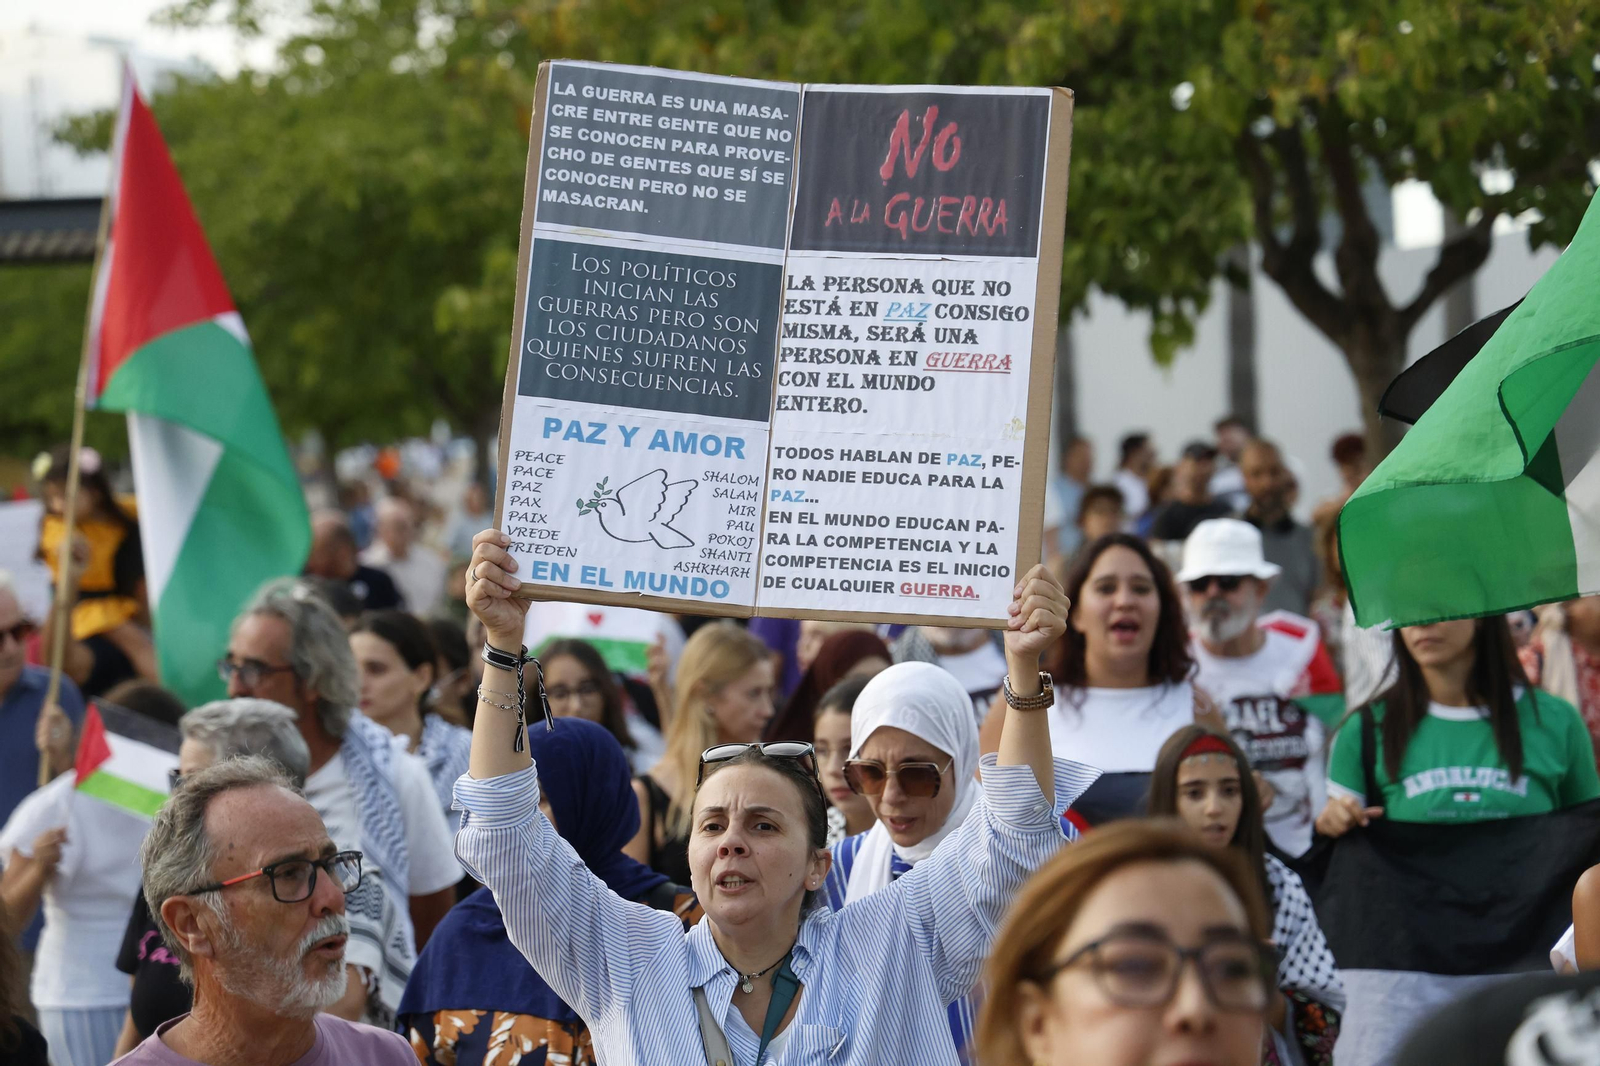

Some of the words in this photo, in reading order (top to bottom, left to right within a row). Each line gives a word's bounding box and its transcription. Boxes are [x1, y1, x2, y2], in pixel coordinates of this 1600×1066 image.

[554, 82, 577, 96] LA
[582, 85, 656, 106] GUERRA
[662, 95, 684, 109] ES
[690, 98, 728, 114] UNA
[733, 103, 789, 120] MASA-
[552, 104, 588, 119] CRE
[593, 108, 653, 127] ENTRE
[658, 116, 718, 134] GENTE
[723, 124, 761, 139] QUE
[766, 128, 792, 142] NO
[549, 125, 572, 139] SE
[578, 128, 666, 150] CONOCEN
[671, 139, 719, 156] PARA
[724, 145, 790, 164] PROVE-
[548, 147, 586, 162] CHO
[591, 151, 615, 166] DE
[620, 155, 692, 175] GENTES
[697, 164, 735, 180] QUE
[739, 166, 758, 182] SÍ
[762, 171, 785, 185] SE
[545, 168, 634, 190] CONOCEN
[639, 179, 687, 196] PERO
[692, 185, 718, 199] NO
[723, 188, 747, 203] SE
[543, 189, 648, 213] MASACRAN.
[825, 198, 841, 226] A
[885, 192, 1007, 239] GUERRA
[621, 261, 737, 288] POLÍTICOS
[584, 279, 674, 303] INICIAN
[684, 290, 719, 308] LAS
[786, 275, 816, 291] LA
[822, 276, 925, 294] PERSONA
[932, 279, 975, 297] QUE
[981, 280, 1011, 297] NO
[538, 296, 638, 321] GUERRAS
[649, 308, 705, 328] PERO
[713, 315, 759, 334] SON
[784, 295, 842, 316] ESTÁ
[849, 301, 879, 317] EN
[886, 302, 933, 319] PAZ
[935, 303, 1029, 322] CONSIGO
[548, 319, 586, 337] LOS
[595, 324, 746, 355] CIUDADANOS
[782, 322, 859, 343] MISMA,
[866, 322, 927, 342] SERÁ
[934, 327, 979, 345] UNA
[527, 338, 623, 363] QUIENES
[632, 350, 716, 373] SUFREN
[727, 360, 761, 378] LAS
[780, 347, 882, 366] PERSONA
[888, 350, 918, 367] EN
[924, 352, 1013, 371] GUERRA
[546, 360, 738, 398] CONSECUENCIAS.
[778, 371, 821, 387] CON
[826, 372, 855, 389] EL
[860, 373, 935, 391] MUNDO
[776, 395, 868, 414] ENTERO.
[543, 417, 607, 445] PAZ
[618, 425, 640, 448] Y
[648, 429, 745, 460] AMOR
[515, 450, 566, 465] PEACE
[774, 446, 834, 460] TODOS
[840, 449, 912, 464] HABLAN
[918, 452, 941, 465] DE
[947, 453, 986, 470] PAZ,
[992, 455, 1020, 468] PE-
[513, 465, 555, 479] PACE
[702, 471, 759, 487] SHALOM
[772, 468, 797, 480] RO
[802, 469, 856, 483] NADIE
[862, 471, 922, 486] EDUCA
[928, 474, 976, 488] PARA
[981, 477, 1004, 490] LA
[512, 480, 543, 493] PAZ
[712, 487, 758, 502] SALAM
[771, 490, 819, 503] PAZ...
[510, 495, 541, 508] PAX
[728, 503, 756, 517] MIR
[508, 511, 547, 524] PAIX
[727, 520, 755, 532] PAU
[769, 511, 792, 524] EN
[798, 512, 819, 525] EL
[824, 513, 890, 528] MUNDO
[896, 516, 970, 532] EDUCAN
[976, 520, 1005, 533] PA-
[507, 525, 561, 541] VREDE
[708, 533, 755, 549] POKOJ
[767, 533, 790, 545] RA
[796, 534, 818, 547] LA
[823, 535, 953, 553] COMPETENCIA
[958, 541, 971, 553] Y
[976, 542, 998, 555] LA
[505, 543, 577, 558] FRIEDEN
[699, 547, 752, 563] SHANTI
[673, 561, 751, 578] ASHKHARH
[765, 554, 893, 572] COMPETENCIA
[899, 560, 921, 573] ES
[927, 562, 949, 574] EL
[954, 563, 1010, 578] INICIO
[532, 560, 570, 583] EN
[580, 565, 613, 587] EL
[624, 570, 730, 599] MUNDO
[763, 576, 786, 589] DE
[791, 577, 895, 594] CUALQUIER
[899, 582, 980, 599] GUERRA.
